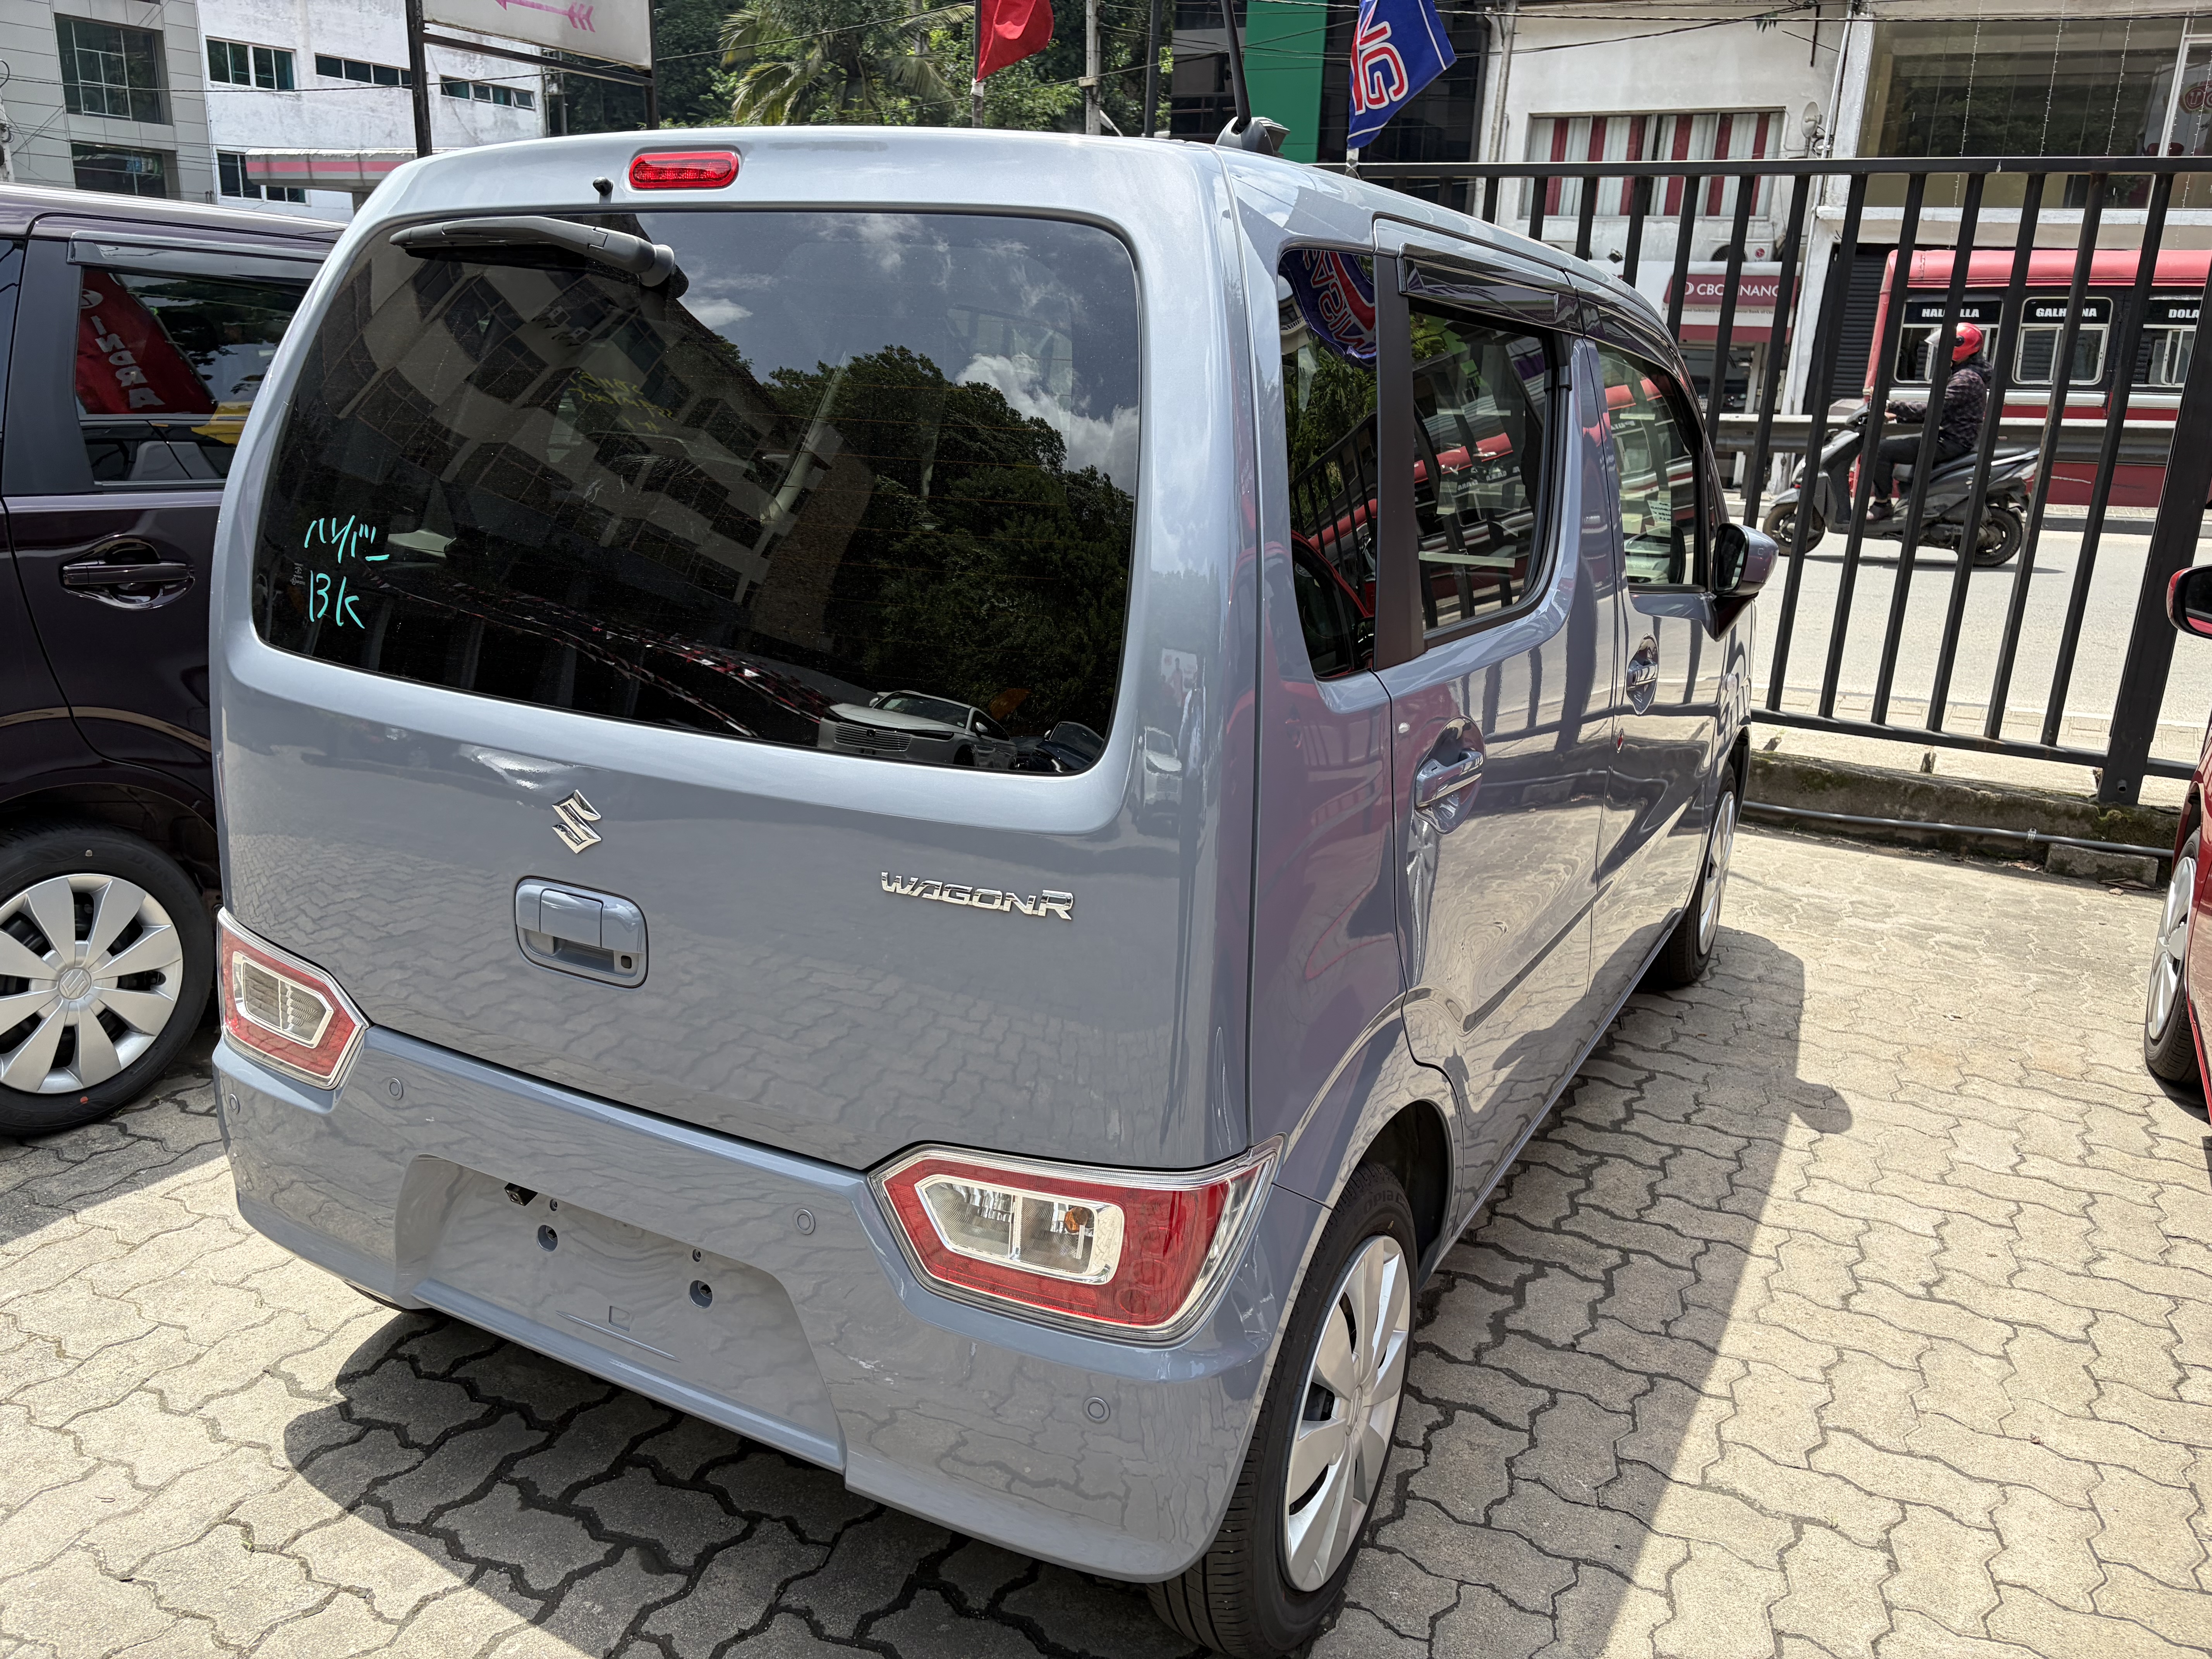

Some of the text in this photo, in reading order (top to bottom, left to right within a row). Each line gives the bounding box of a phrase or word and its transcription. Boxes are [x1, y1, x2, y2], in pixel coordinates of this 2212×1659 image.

[1697, 283, 1725, 296] CBC
[1921, 308, 1980, 318] HALLLA
[2035, 307, 2097, 317] GALHNA
[2168, 309, 2200, 318] DOLA
